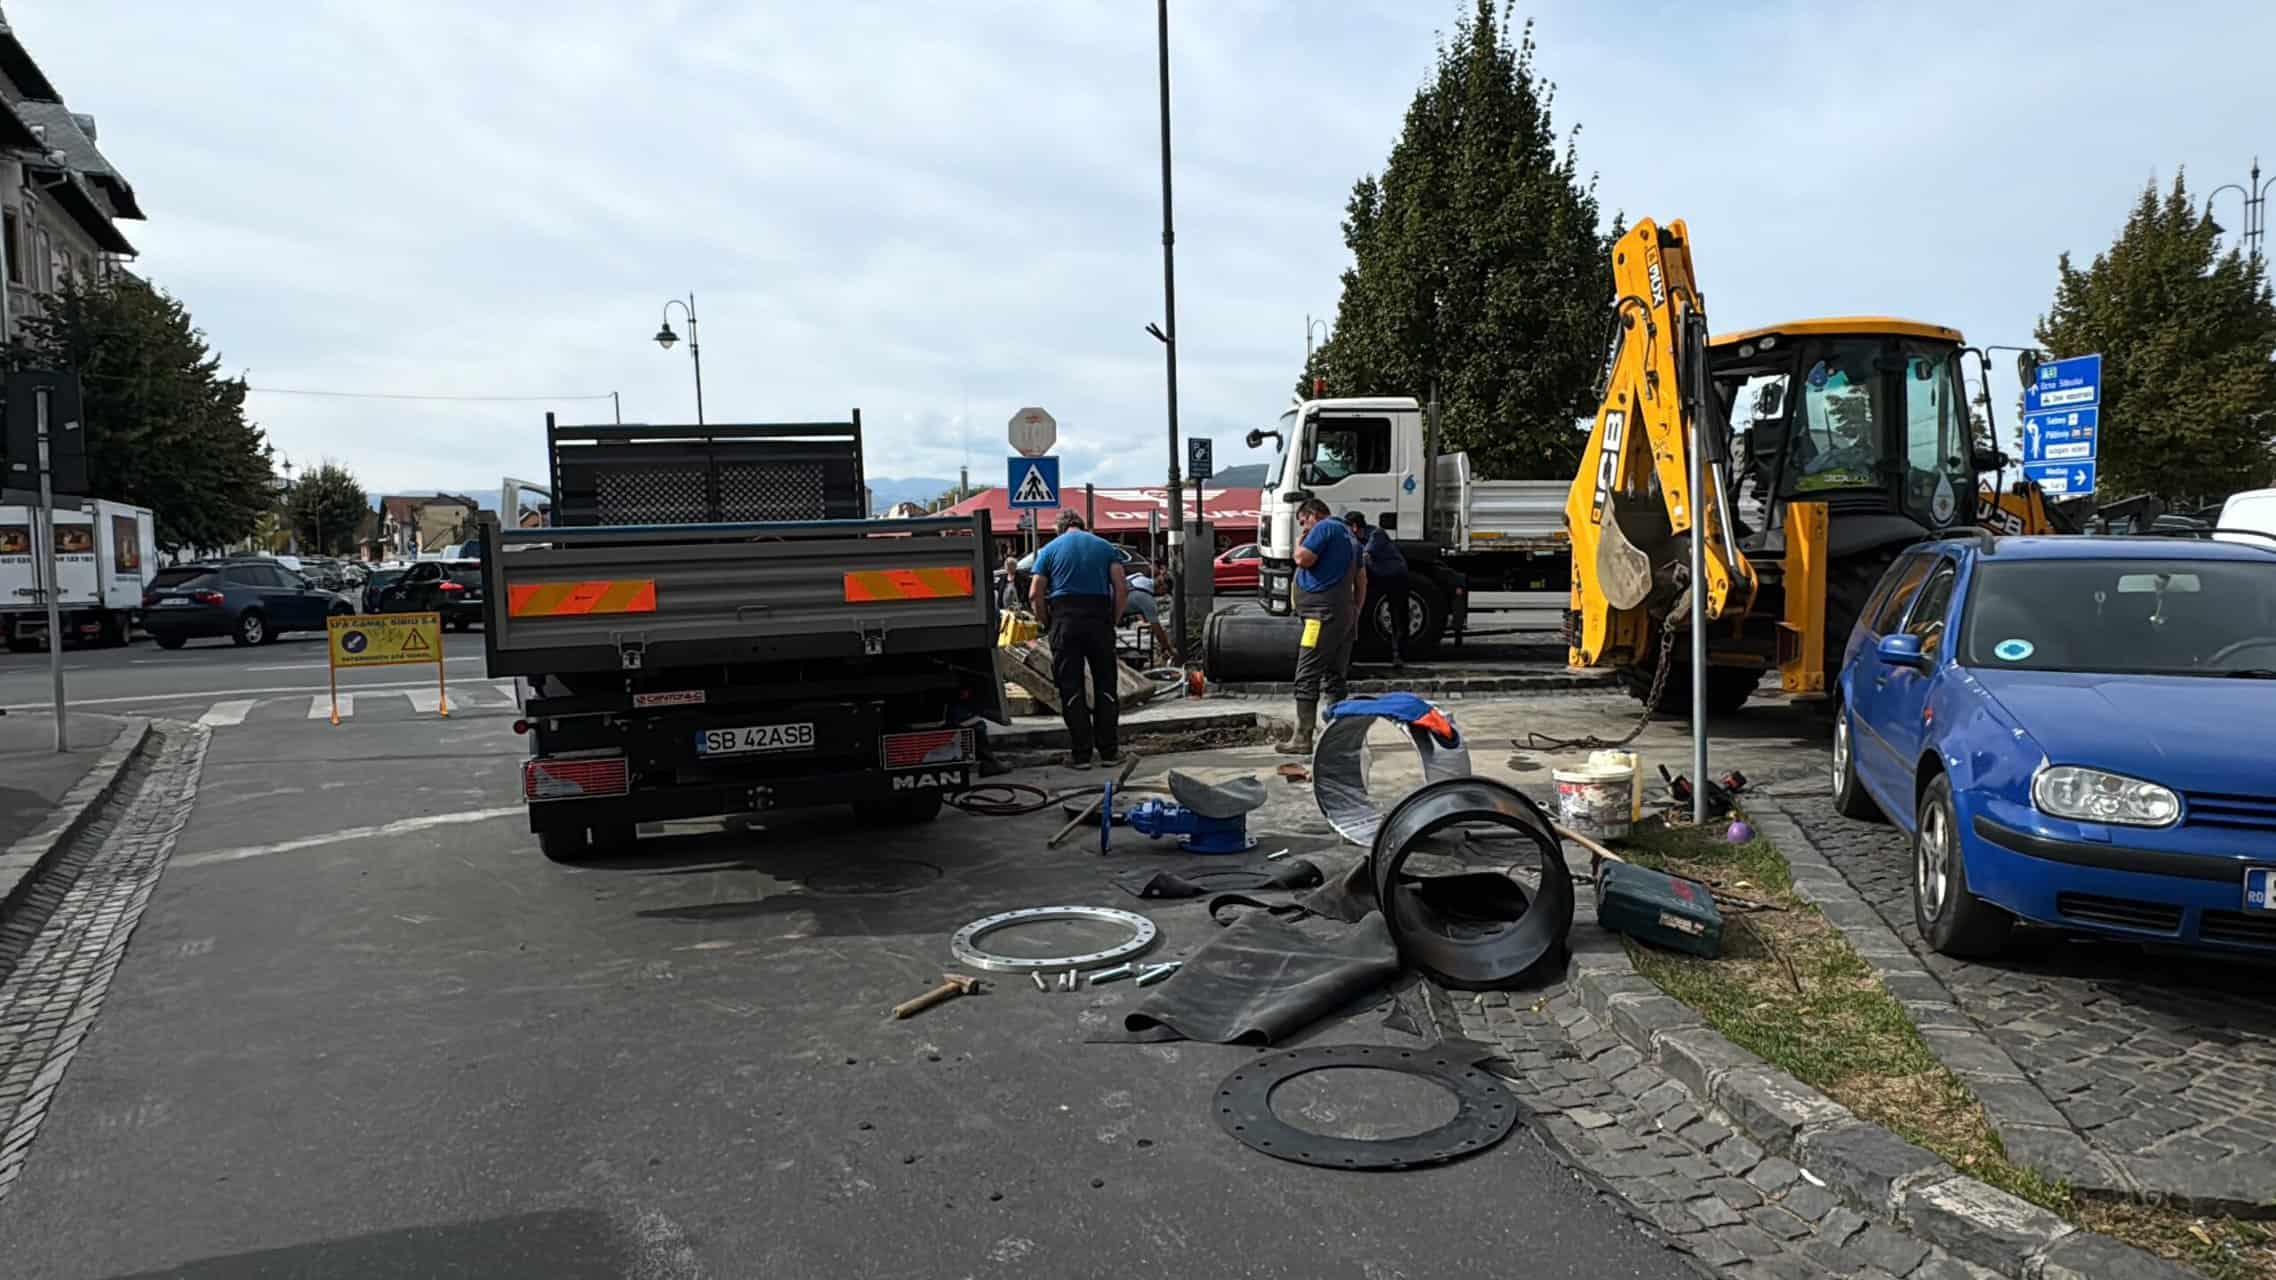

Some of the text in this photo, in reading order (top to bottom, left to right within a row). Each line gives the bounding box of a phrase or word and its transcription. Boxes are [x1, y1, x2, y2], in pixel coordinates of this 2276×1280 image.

[1648, 263, 1665, 306] 3CX
[1976, 502, 2021, 536] JCB
[707, 724, 813, 751] SB 42ASB
[893, 771, 961, 790] MAN
[2248, 890, 2264, 903] RO
